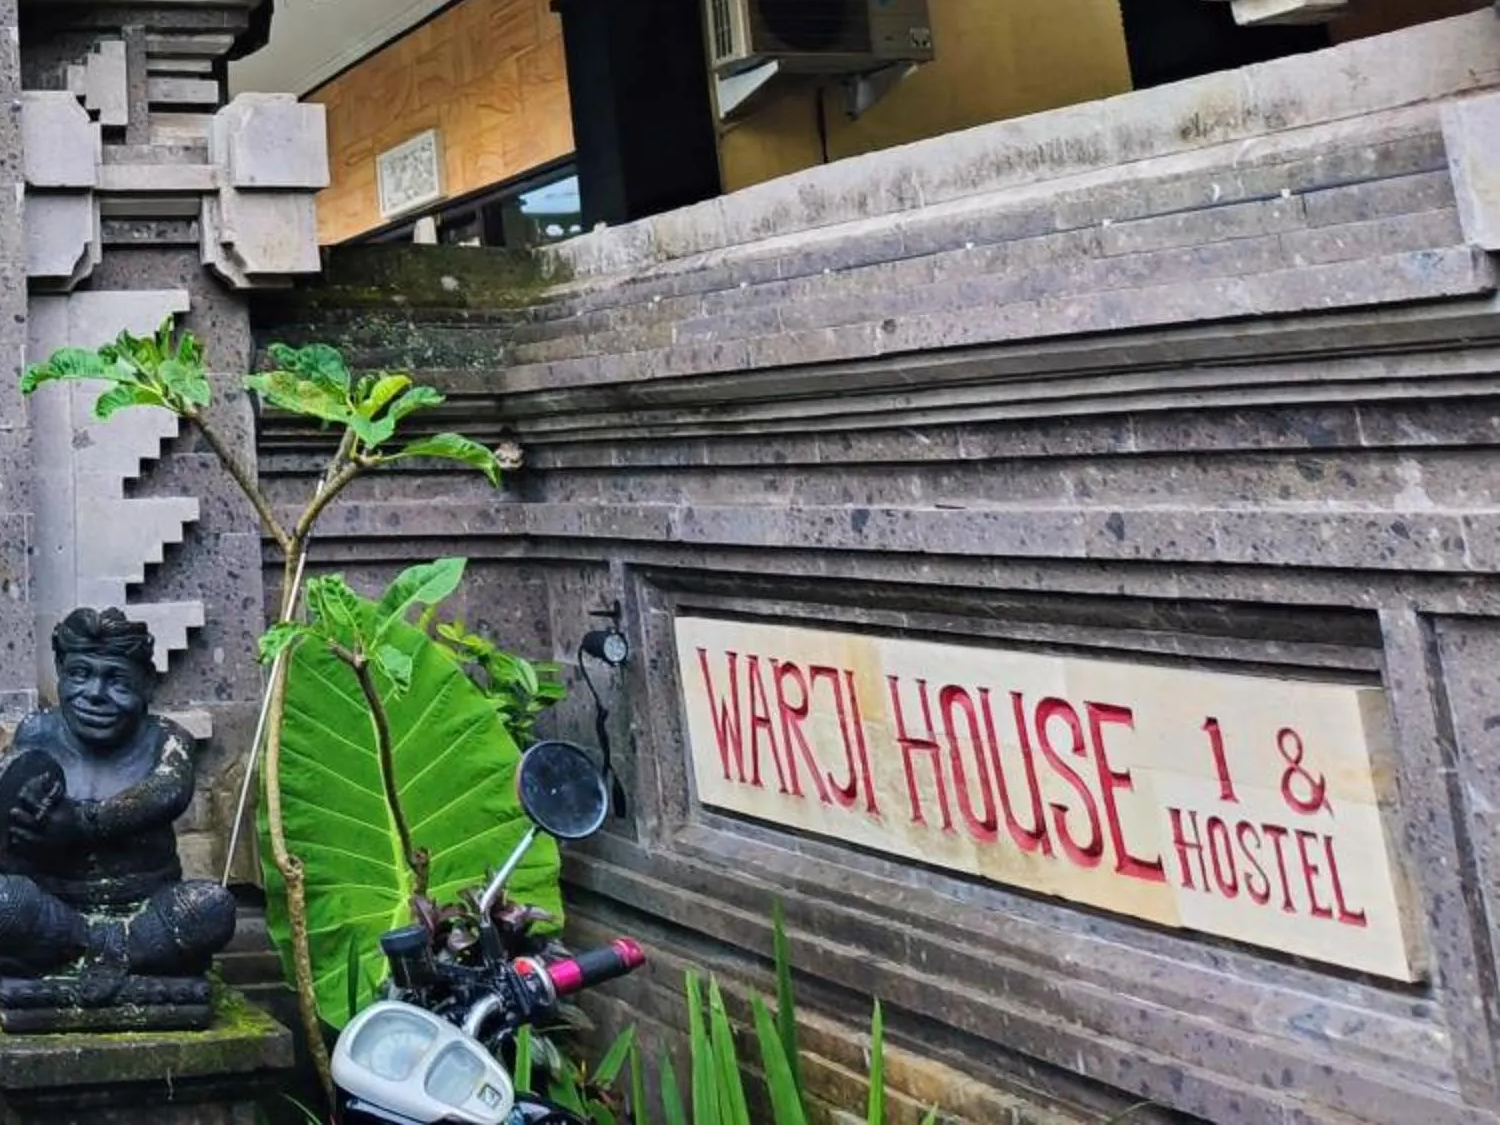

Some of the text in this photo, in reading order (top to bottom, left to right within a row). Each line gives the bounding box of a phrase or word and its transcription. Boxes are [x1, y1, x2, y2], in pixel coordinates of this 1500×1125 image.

[697, 647, 1334, 883] WARJI HOUSE 1 &
[1168, 807, 1367, 927] HOSTEL
